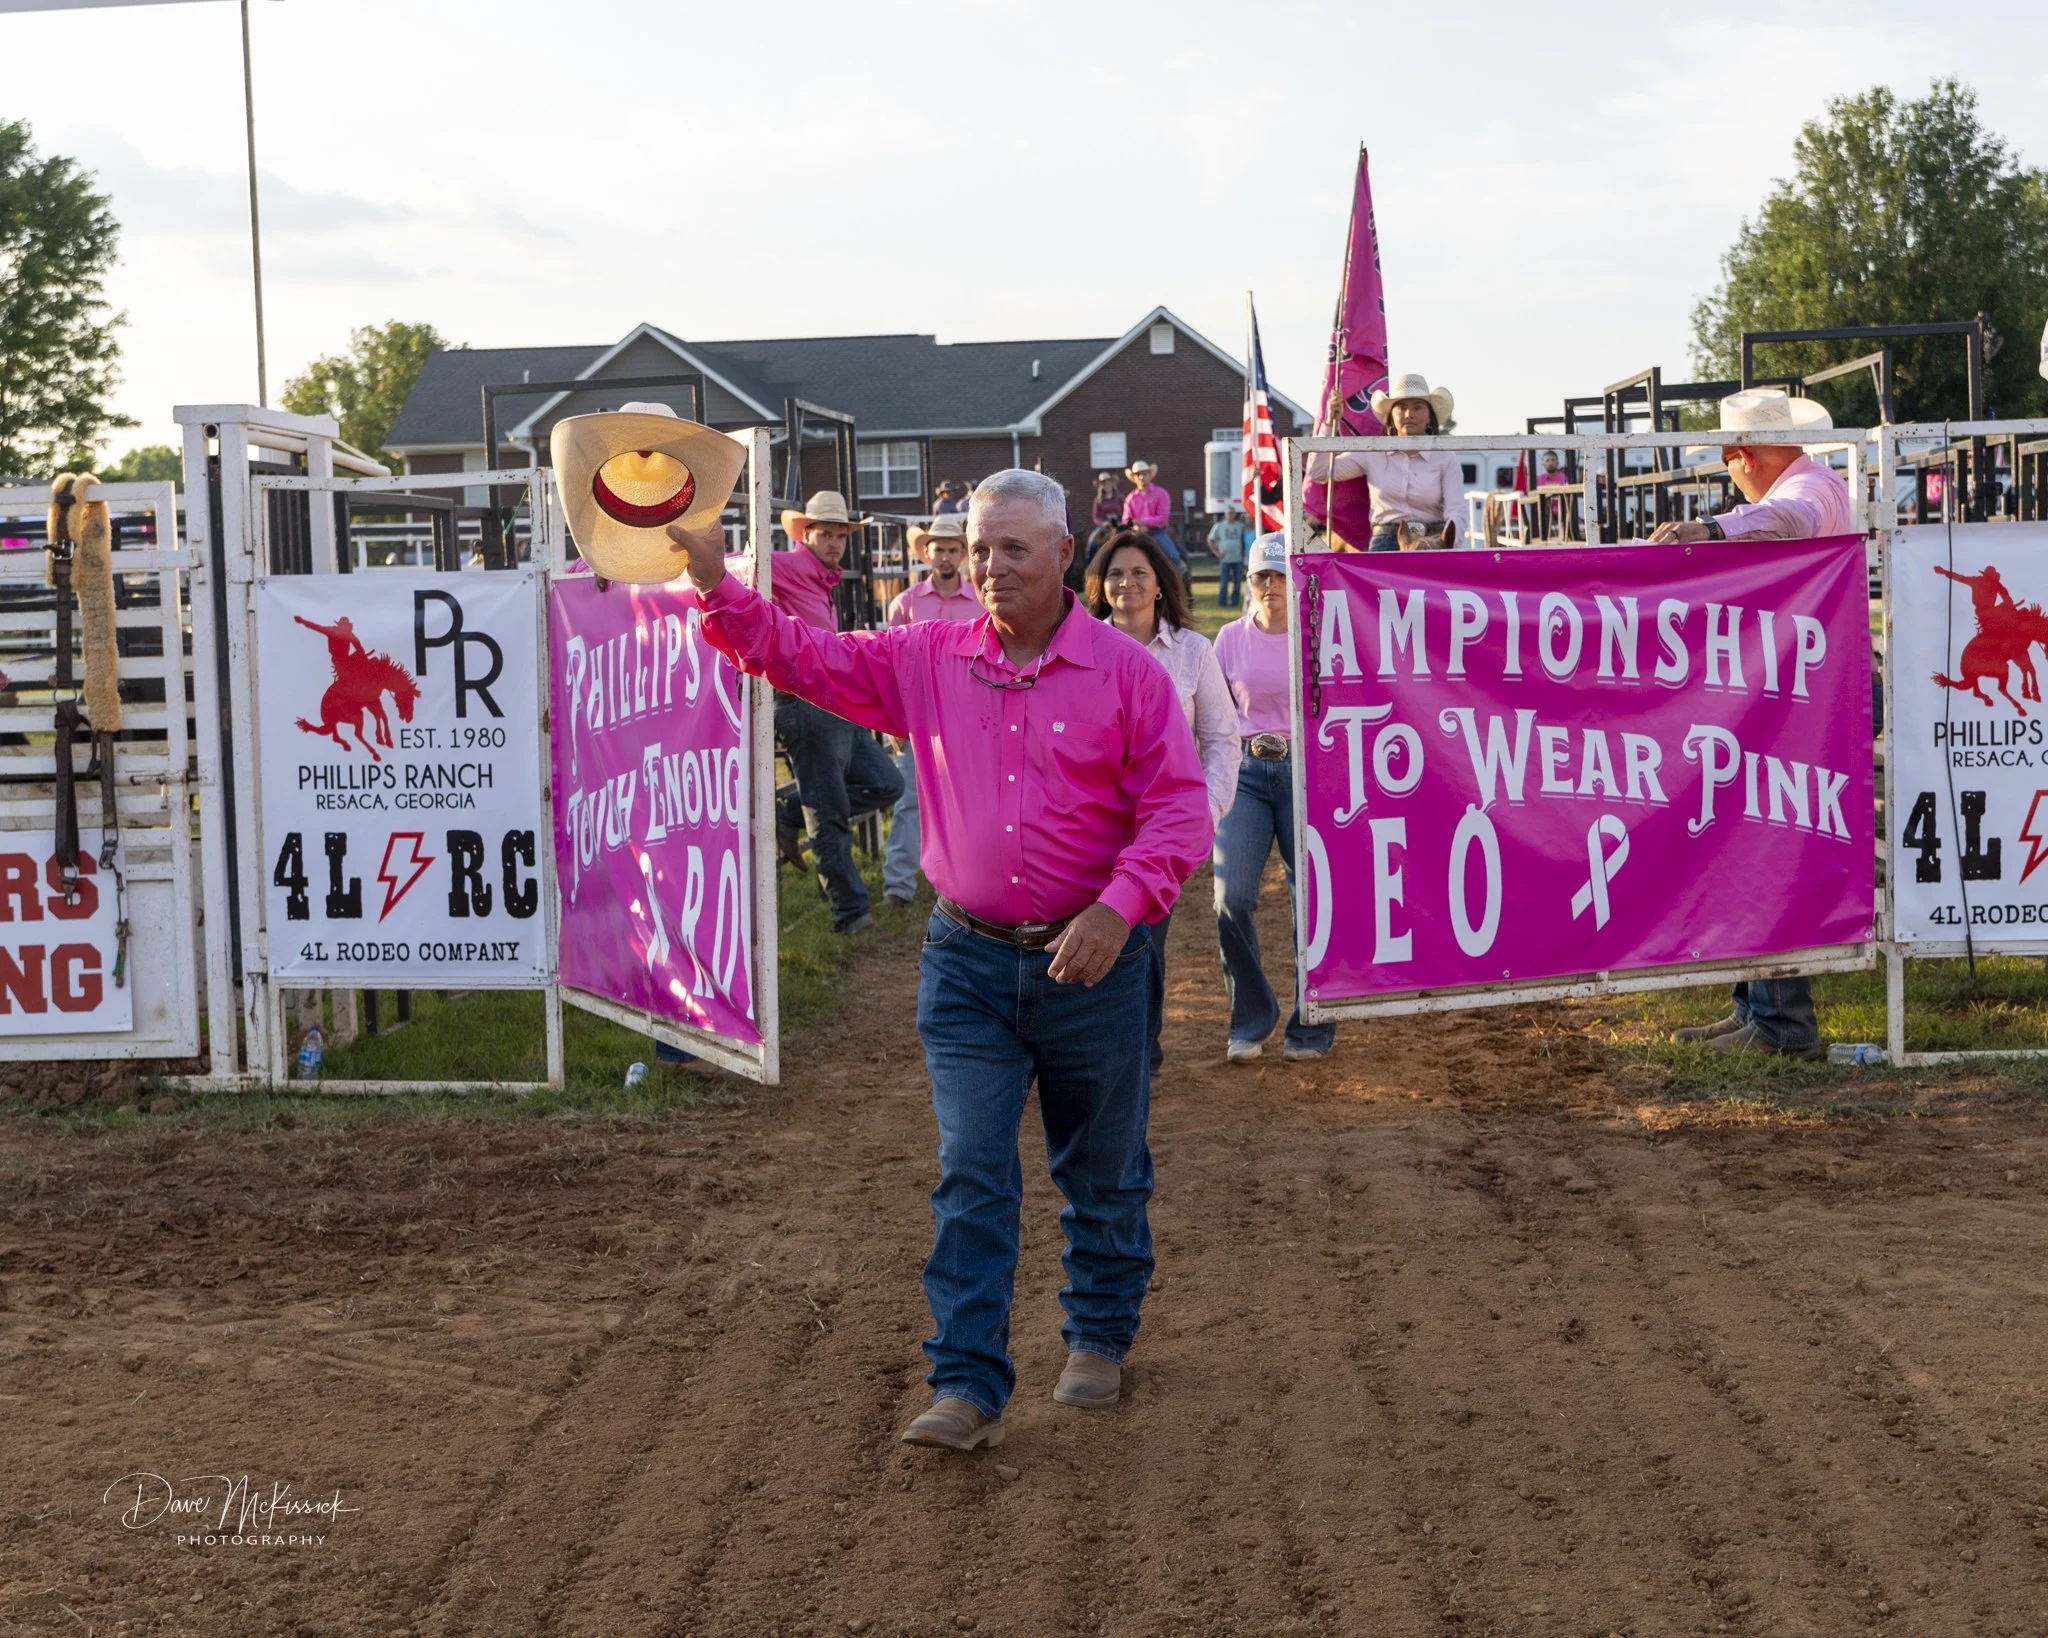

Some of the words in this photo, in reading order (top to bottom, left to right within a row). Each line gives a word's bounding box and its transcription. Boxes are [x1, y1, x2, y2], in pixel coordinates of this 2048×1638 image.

[414, 590, 506, 719] PR
[1297, 587, 1827, 700] AMPIONSHIP
[565, 606, 700, 781] PHILLIPS
[401, 728, 442, 749] EST.
[450, 727, 506, 748] 1980
[1934, 719, 2043, 748] PHILLIPS
[299, 764, 397, 790] PHILLIPS
[405, 763, 493, 789] RANCH
[1317, 702, 1424, 827] TO
[1439, 706, 1670, 808] WEAR
[1682, 724, 1852, 838] PINK
[1952, 750, 2034, 768] RESACA,
[316, 794, 389, 811] RESACA,
[395, 792, 476, 810] GEORGIA
[1903, 791, 2001, 884] 4L
[274, 832, 363, 921] 4L
[446, 829, 538, 920] RC
[1929, 906, 1961, 925] 4L
[300, 943, 329, 962] 4L
[336, 942, 410, 962] RODEO
[418, 941, 521, 962] COMPANY
[0, 943, 103, 1014] NG
